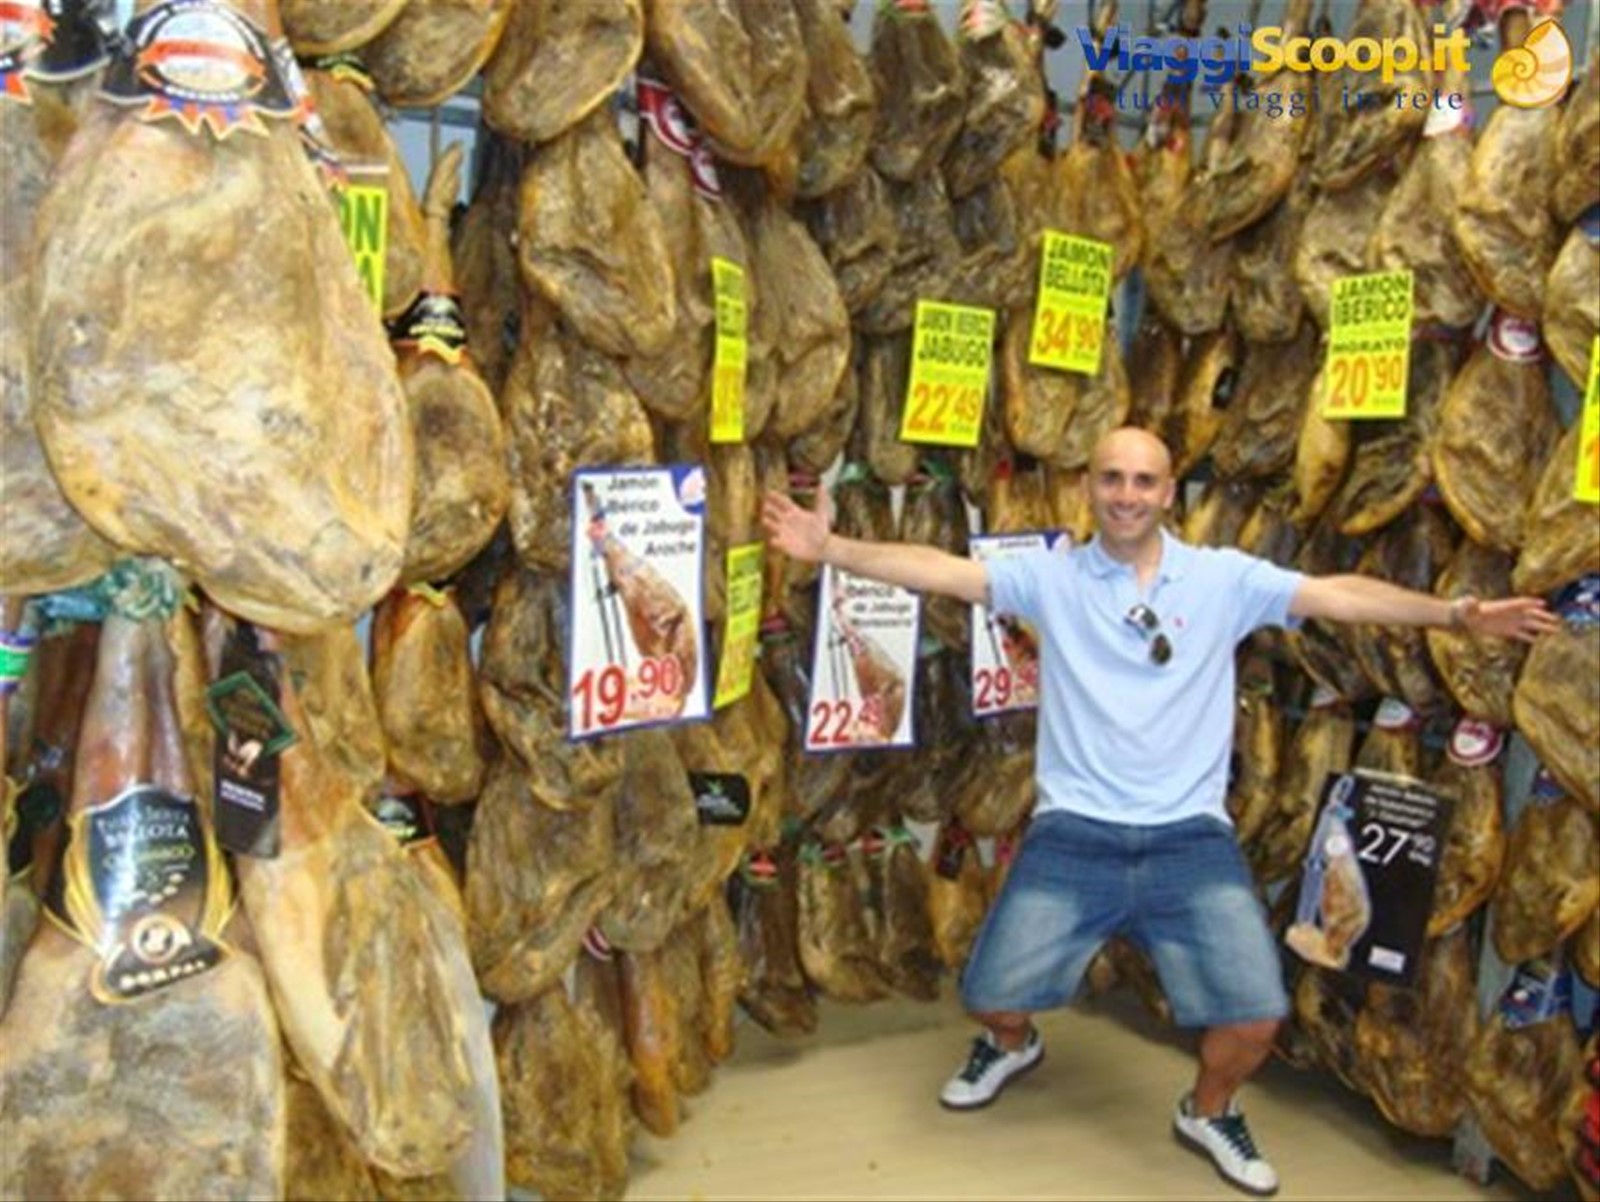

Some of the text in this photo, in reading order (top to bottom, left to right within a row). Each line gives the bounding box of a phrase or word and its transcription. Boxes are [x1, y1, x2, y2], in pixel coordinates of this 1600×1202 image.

[1047, 236, 1109, 271] JAMON
[1335, 275, 1409, 300] JAMON
[1333, 295, 1408, 326] IBERICO
[918, 332, 988, 368] JABUGO
[608, 475, 659, 491] Jamón
[619, 522, 639, 535] de
[573, 654, 681, 730] 19.90
